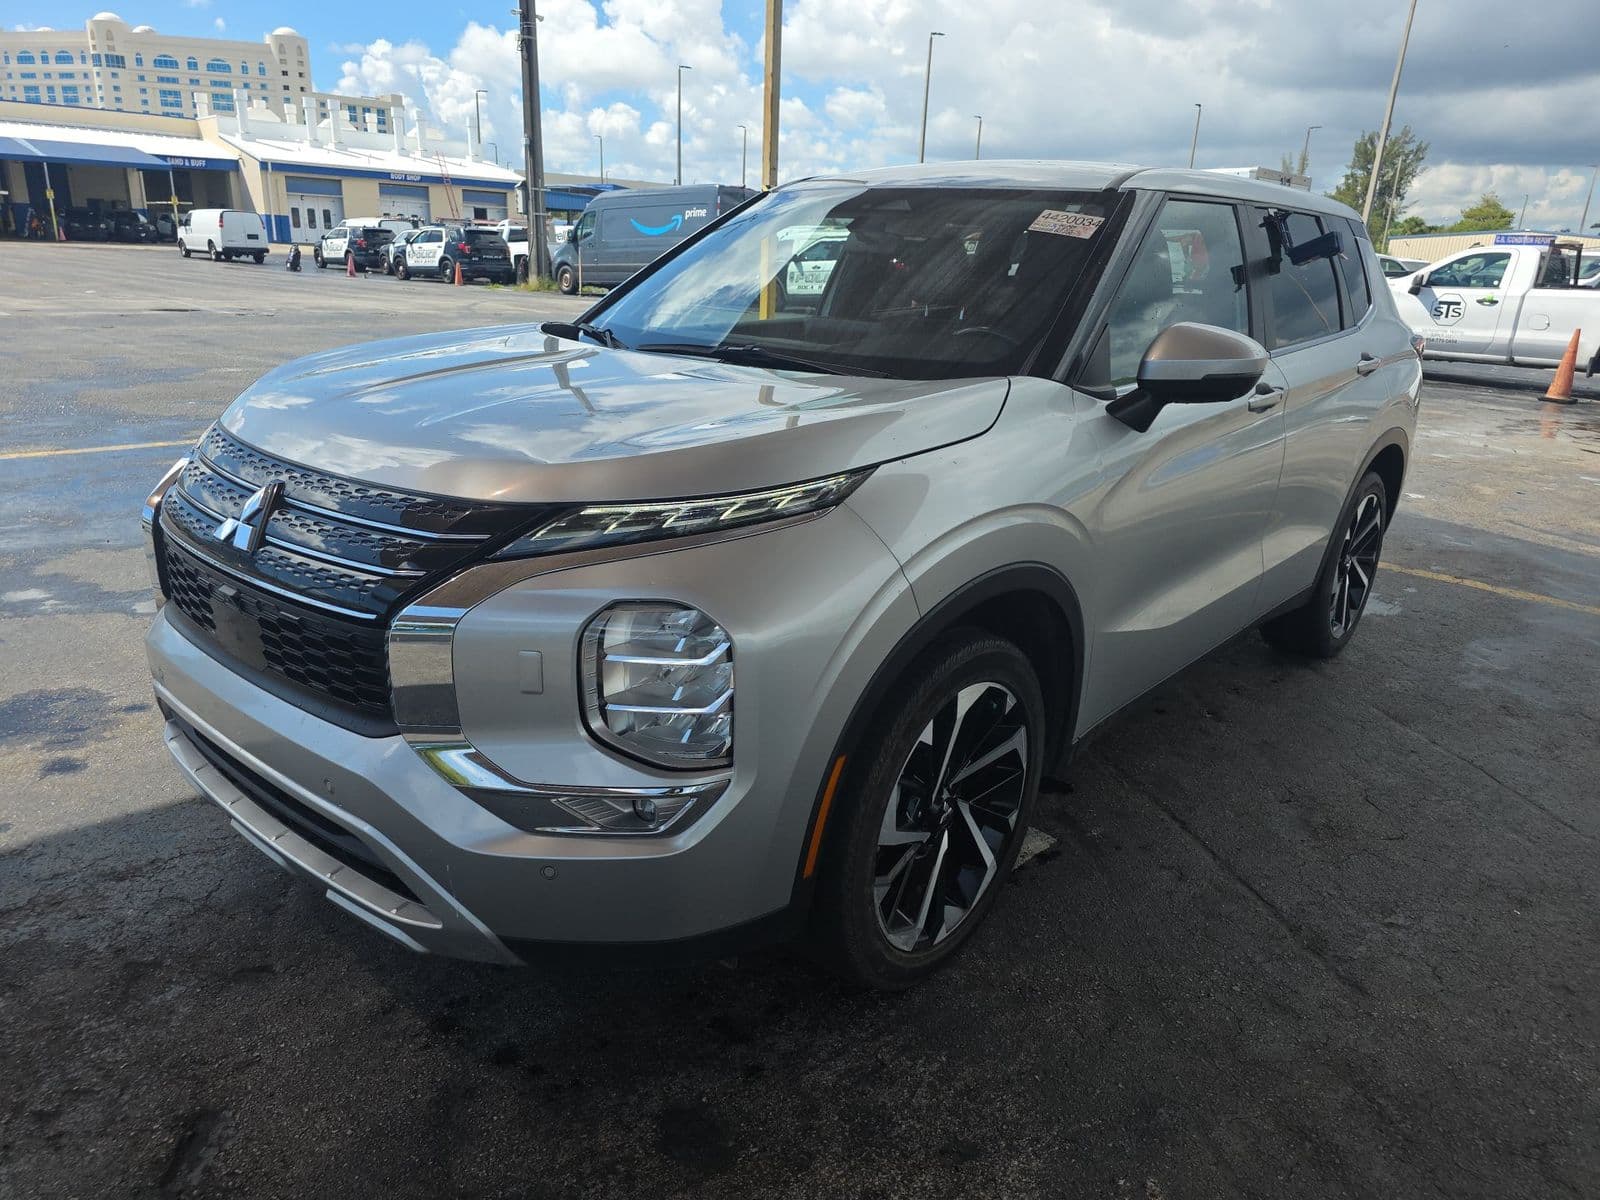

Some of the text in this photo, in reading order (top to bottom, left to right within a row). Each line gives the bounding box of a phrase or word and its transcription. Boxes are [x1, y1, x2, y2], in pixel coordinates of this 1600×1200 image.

[685, 207, 707, 220] prime
[1042, 212, 1103, 227] 4420034
[1433, 301, 1462, 318] STS
